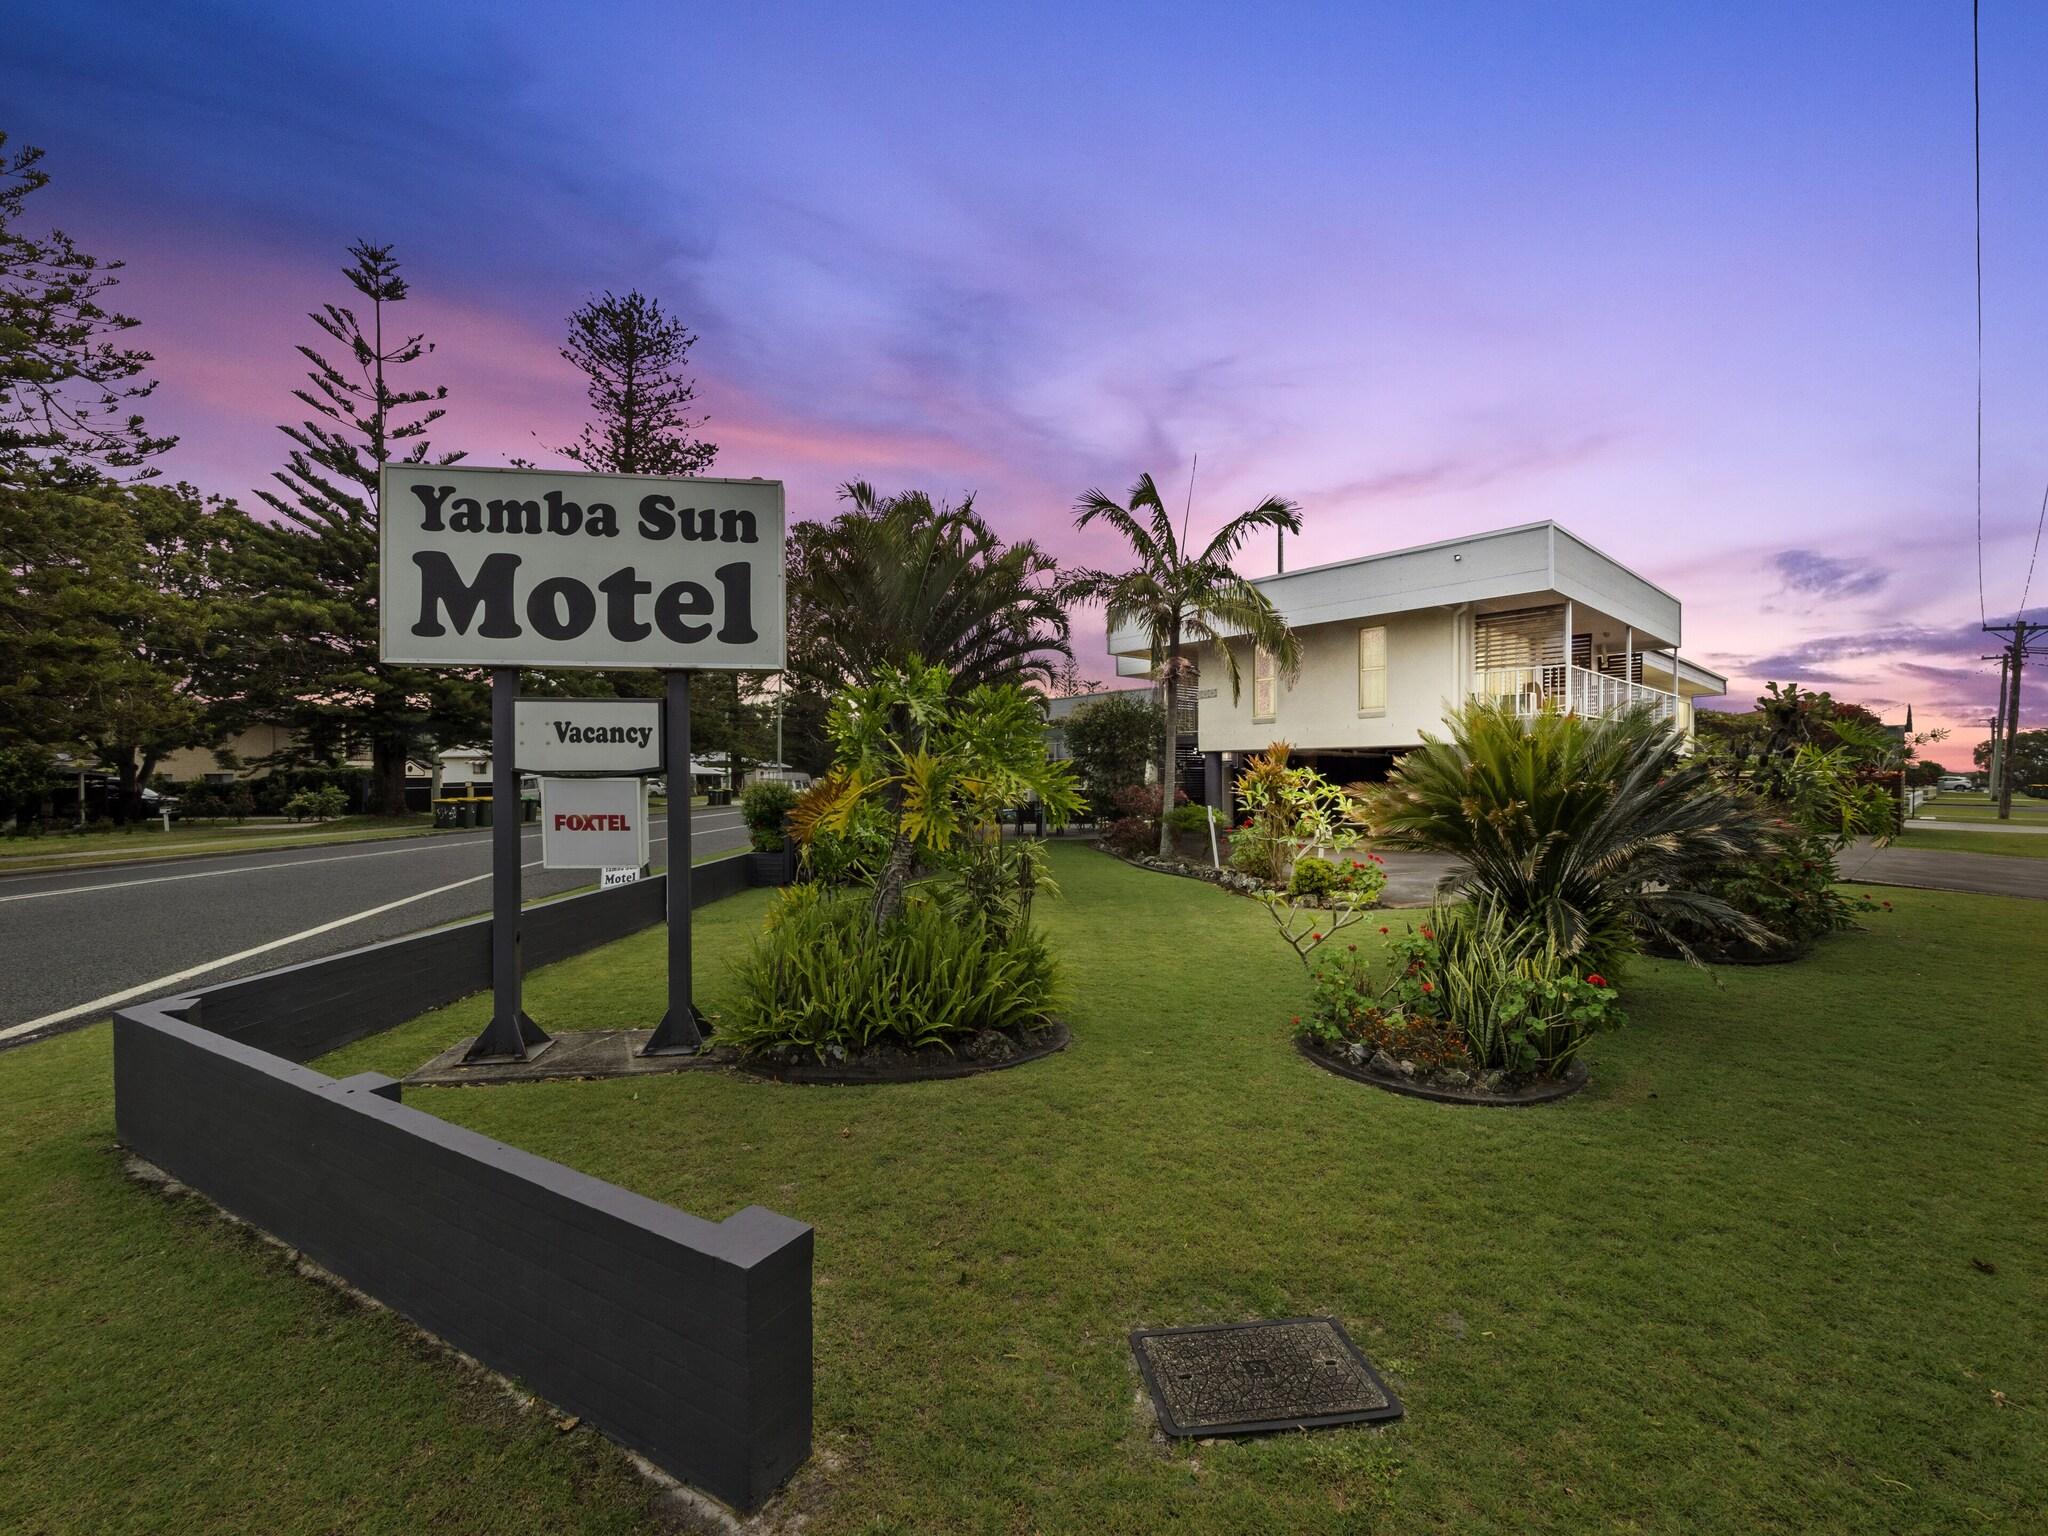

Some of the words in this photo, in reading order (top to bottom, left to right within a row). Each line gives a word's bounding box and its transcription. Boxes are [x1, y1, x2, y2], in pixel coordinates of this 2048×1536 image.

[410, 485, 620, 538] Yamba
[638, 494, 759, 543] Sun
[411, 550, 758, 644] Motel
[553, 721, 653, 748] Vacancy
[554, 814, 631, 832] FOXTEL
[605, 872, 636, 884] Motel
